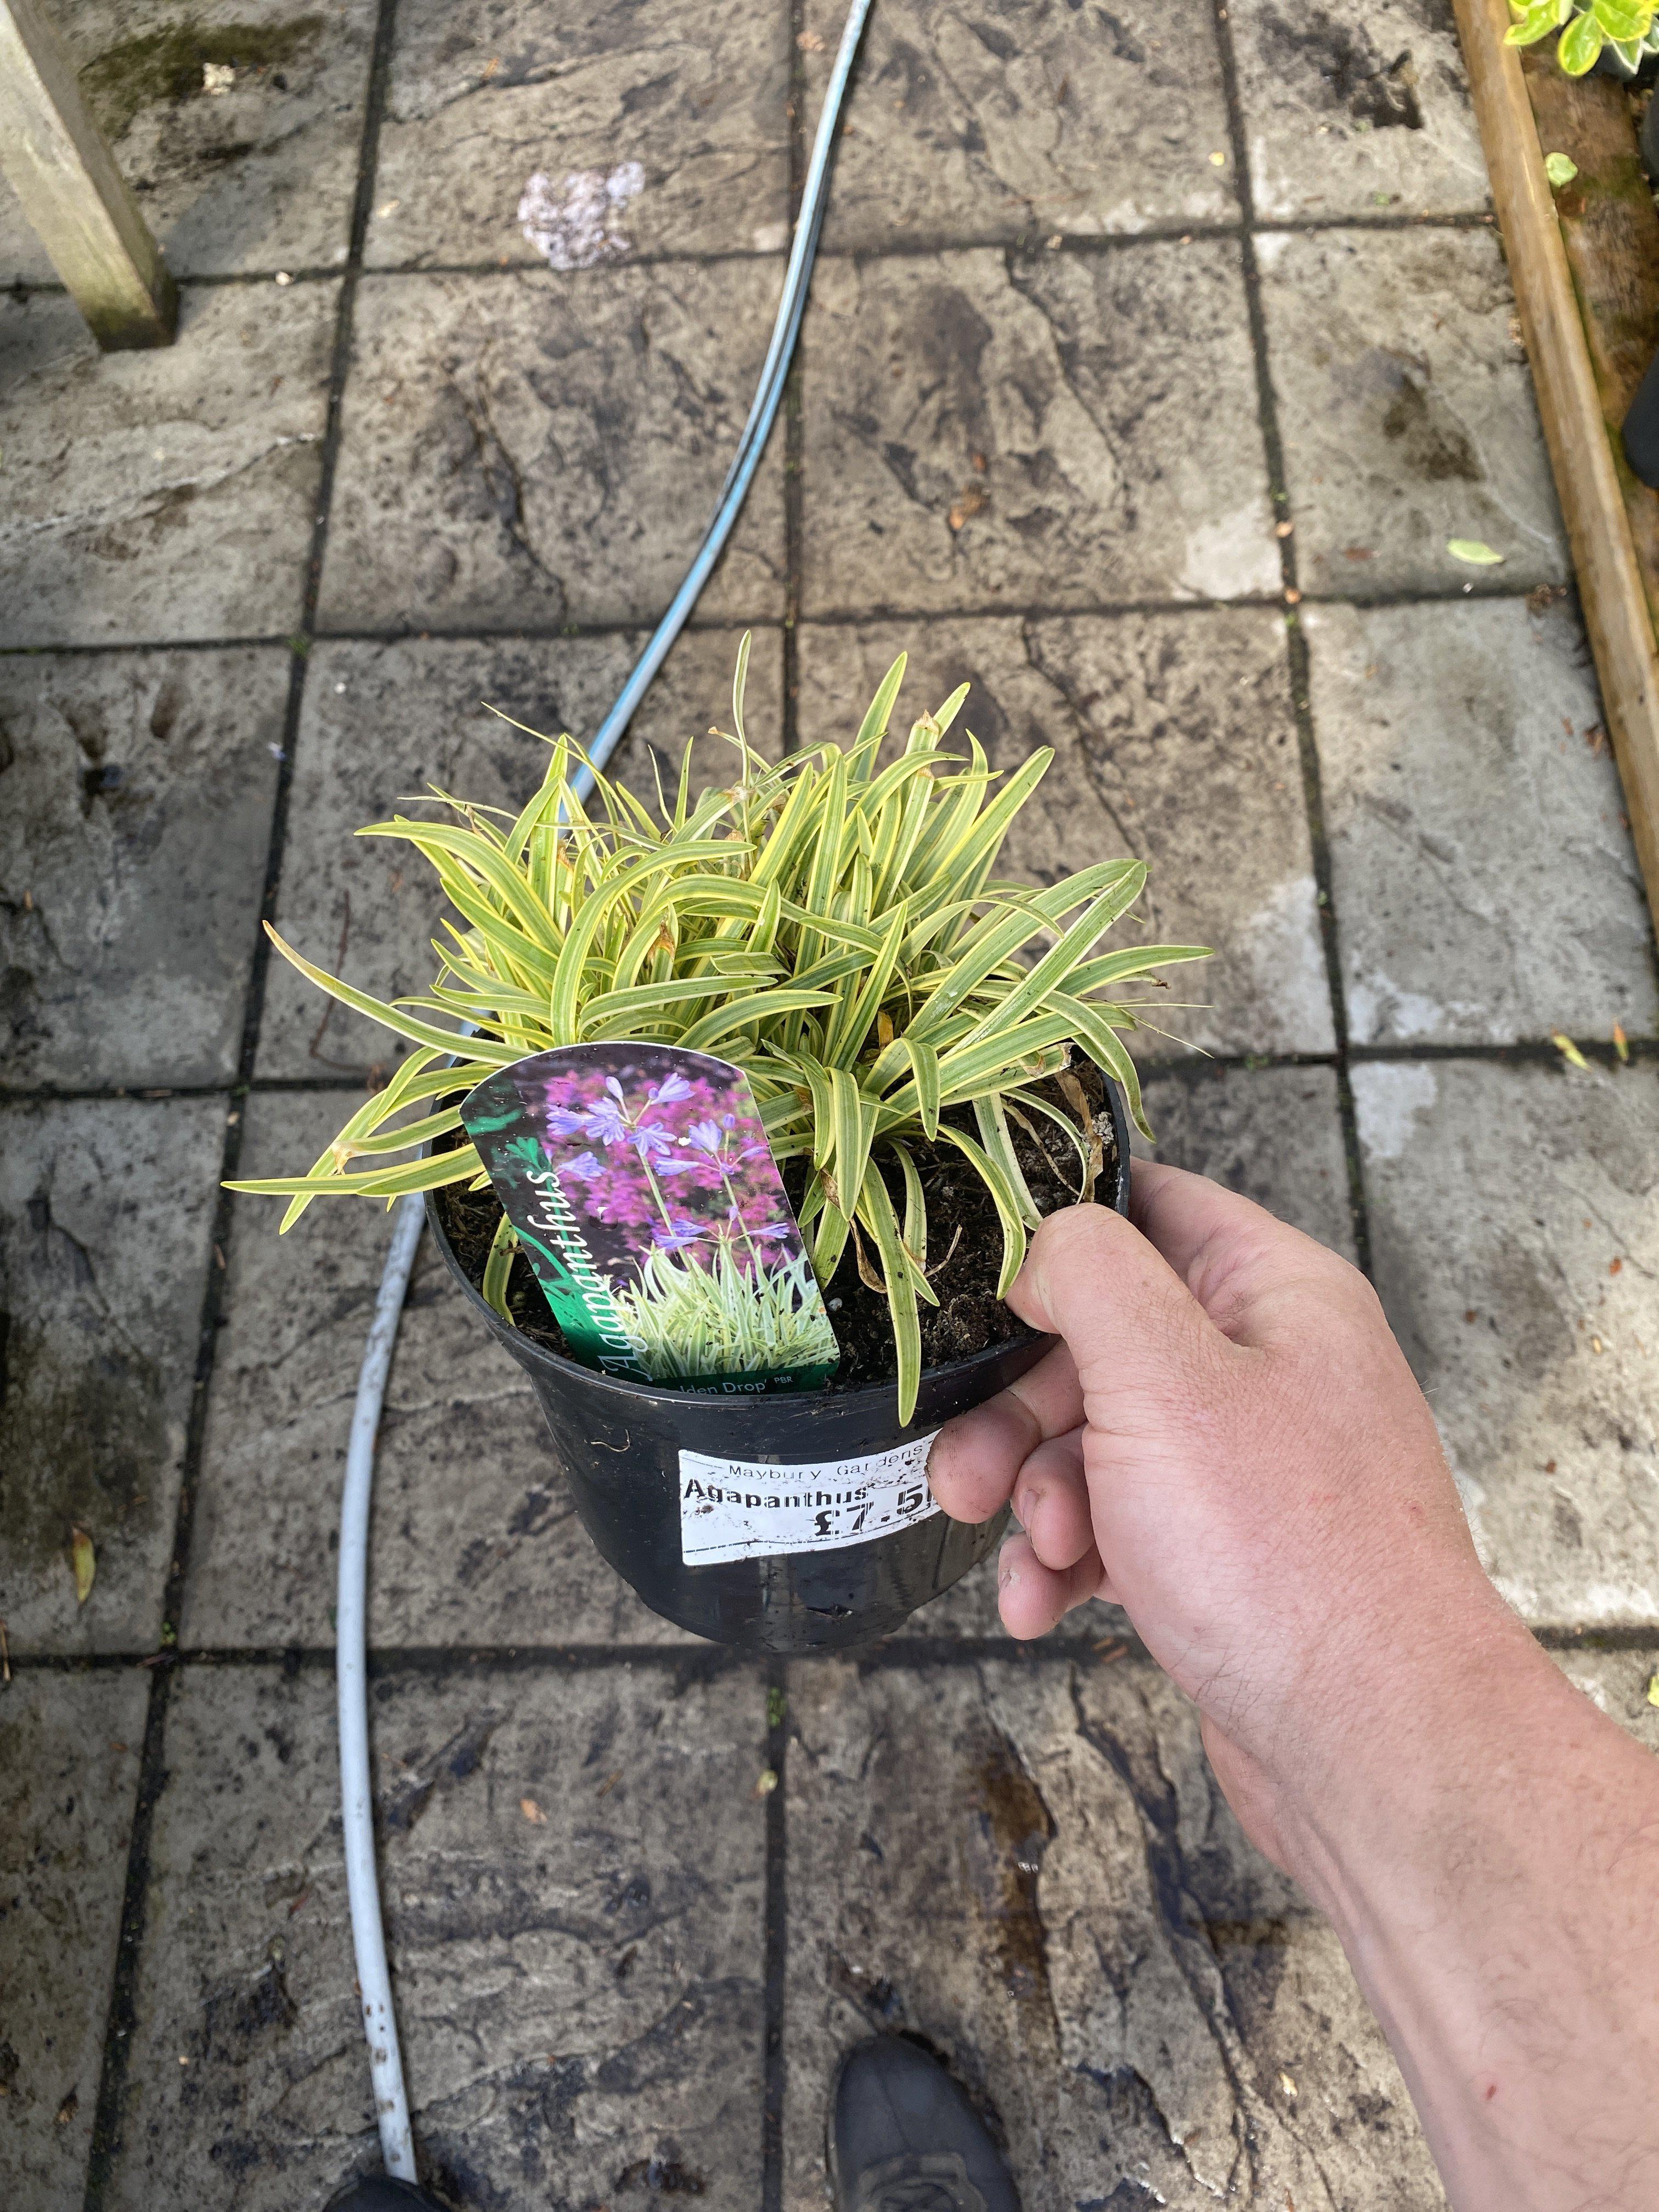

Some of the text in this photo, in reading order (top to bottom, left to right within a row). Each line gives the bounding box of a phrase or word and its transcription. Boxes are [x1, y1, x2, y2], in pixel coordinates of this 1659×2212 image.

[526, 1170, 653, 1382] Agapanthus
[774, 1376, 793, 1384] PBR
[729, 1445, 923, 1480] Maybury Gardens
[684, 1479, 868, 1508] Agapanthus
